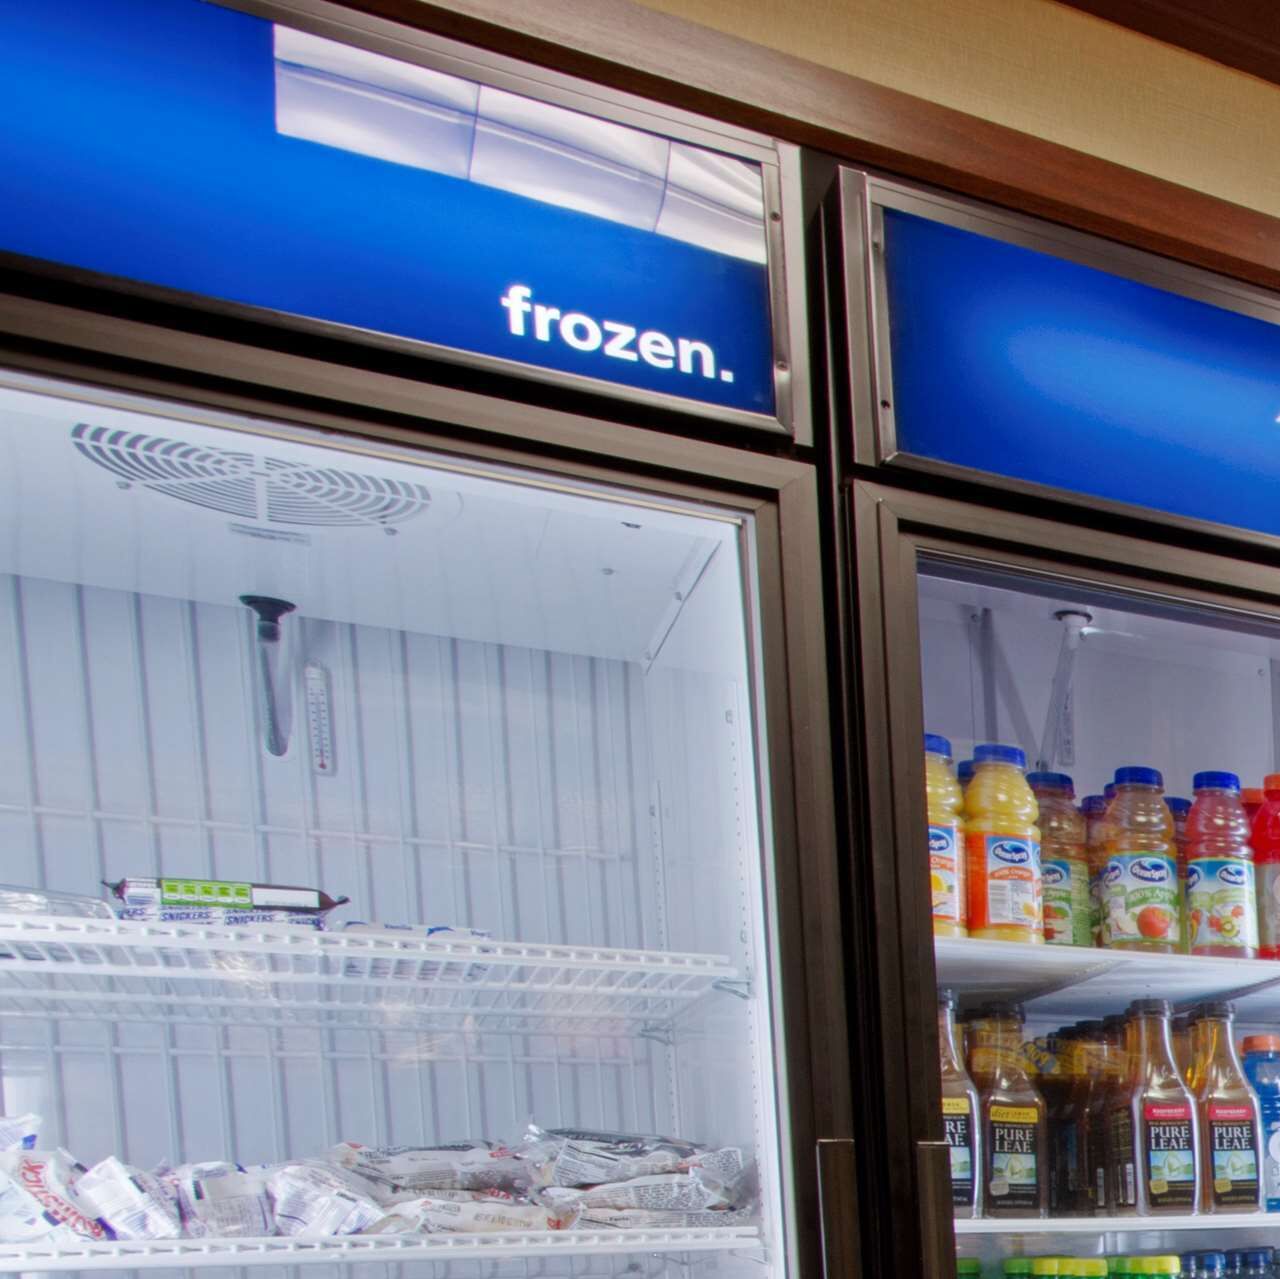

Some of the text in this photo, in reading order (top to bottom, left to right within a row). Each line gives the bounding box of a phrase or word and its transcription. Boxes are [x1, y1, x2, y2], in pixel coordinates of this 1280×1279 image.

[500, 284, 734, 383] frozen.
[995, 1128, 1033, 1141] PURE
[1151, 1126, 1190, 1138] PURE
[1214, 1126, 1252, 1138] PURE
[995, 1140, 1032, 1153] LEAF
[1151, 1138, 1188, 1150] LEAF
[1215, 1138, 1251, 1150] LEAF
